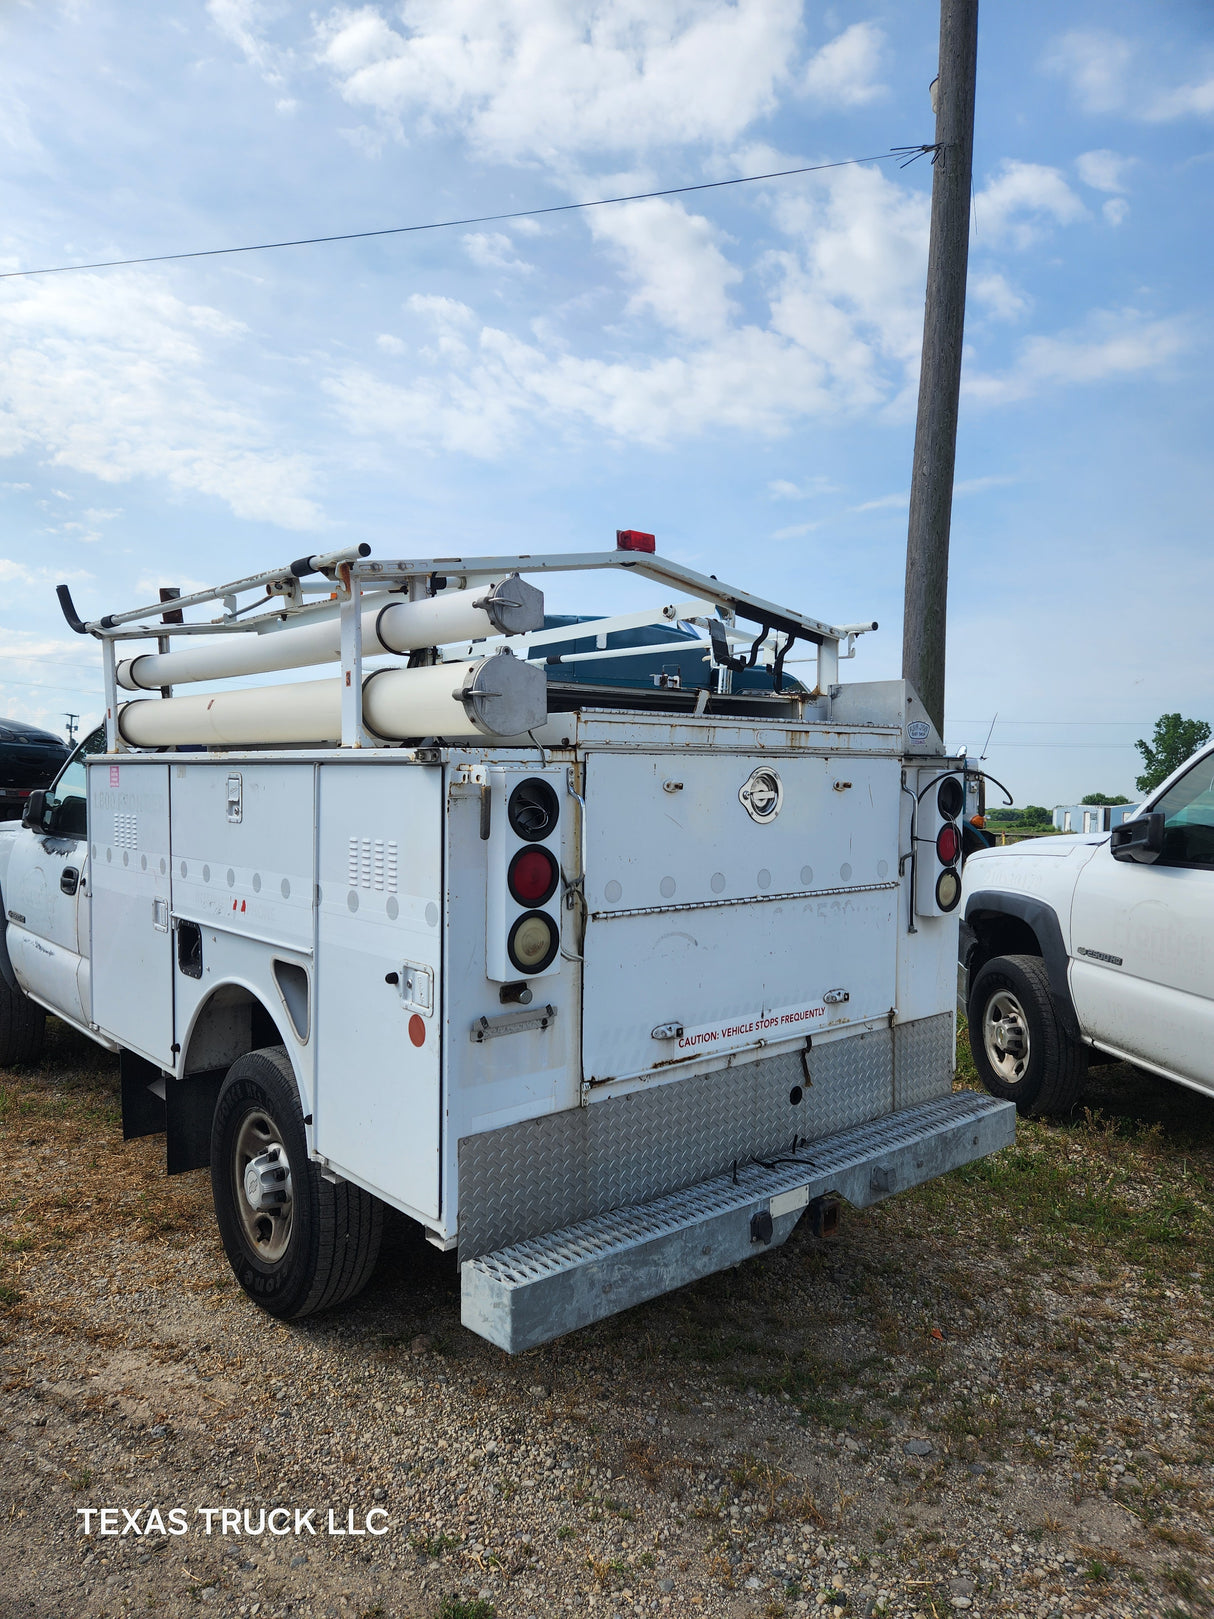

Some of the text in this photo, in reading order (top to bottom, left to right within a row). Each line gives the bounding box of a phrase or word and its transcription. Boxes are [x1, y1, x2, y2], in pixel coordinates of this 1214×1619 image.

[678, 1006, 826, 1049] CAUTION: VEHICLE STOPS FREQUENTLY
